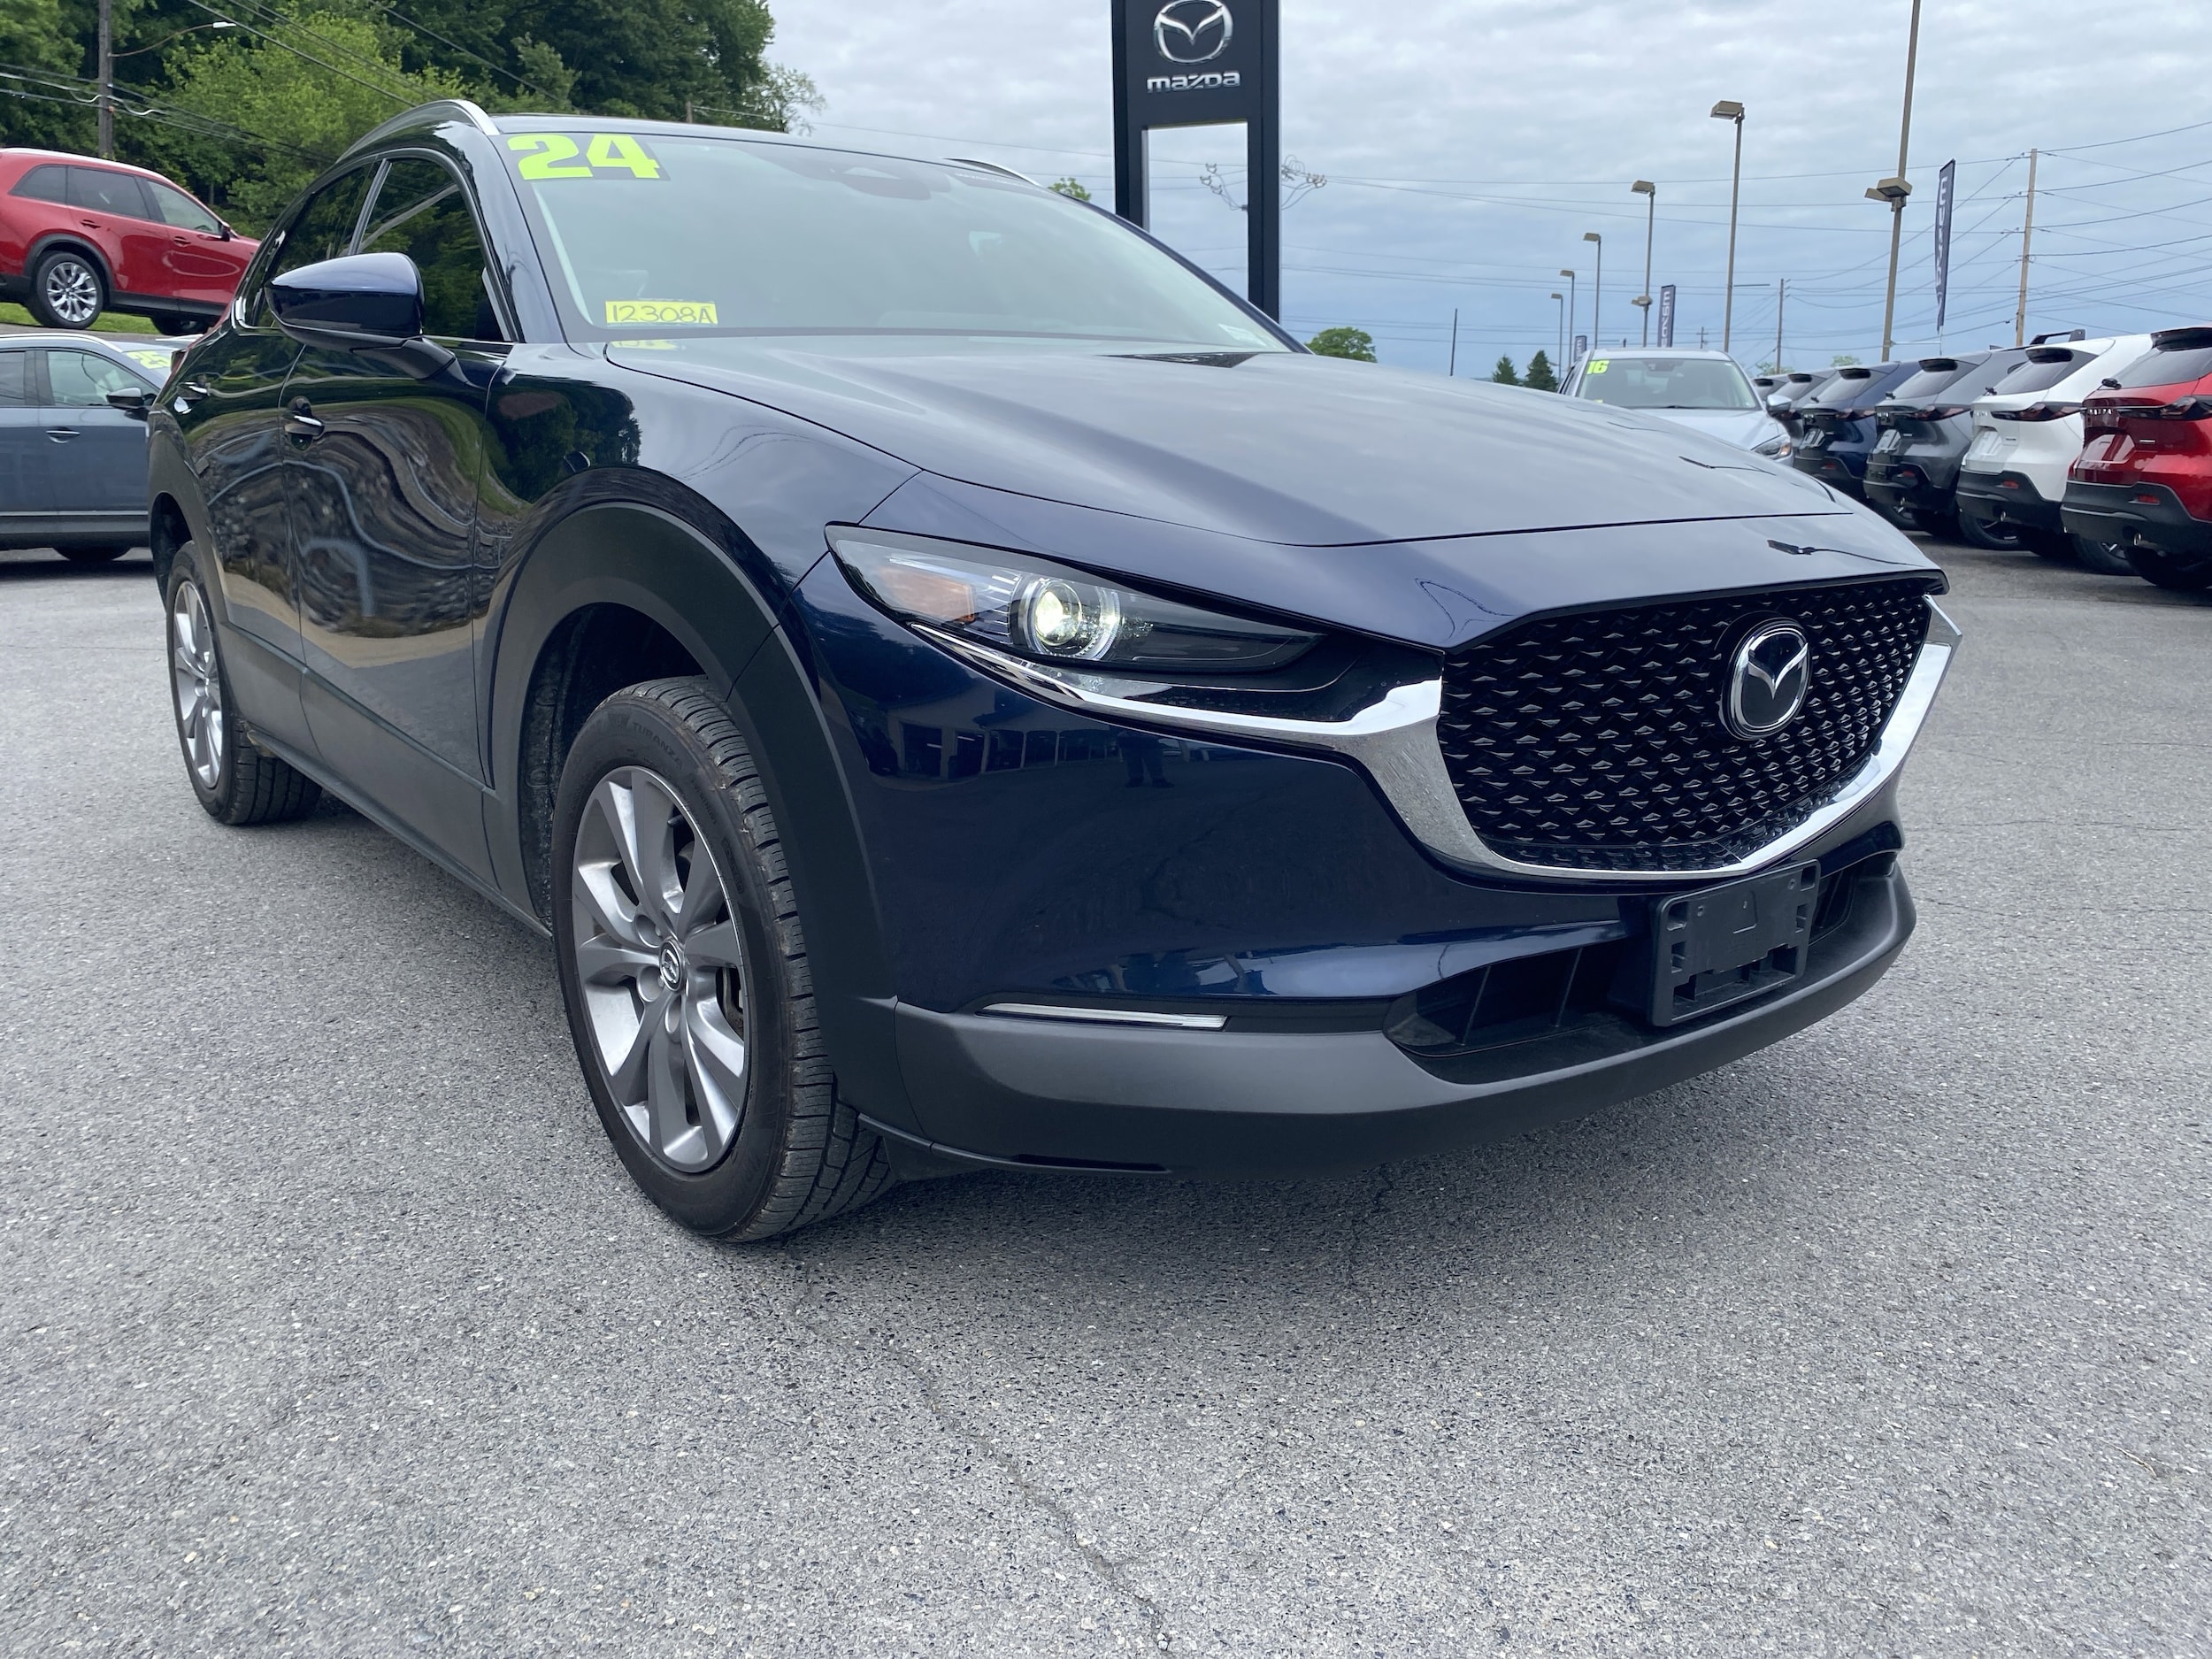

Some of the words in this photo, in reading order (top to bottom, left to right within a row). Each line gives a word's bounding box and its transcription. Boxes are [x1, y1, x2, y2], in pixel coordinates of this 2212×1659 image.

[1146, 70, 1240, 94] mazda
[507, 134, 660, 180] 24
[612, 304, 715, 325] 12308A
[1586, 360, 1609, 374] 16
[633, 721, 683, 771] TURANZA
